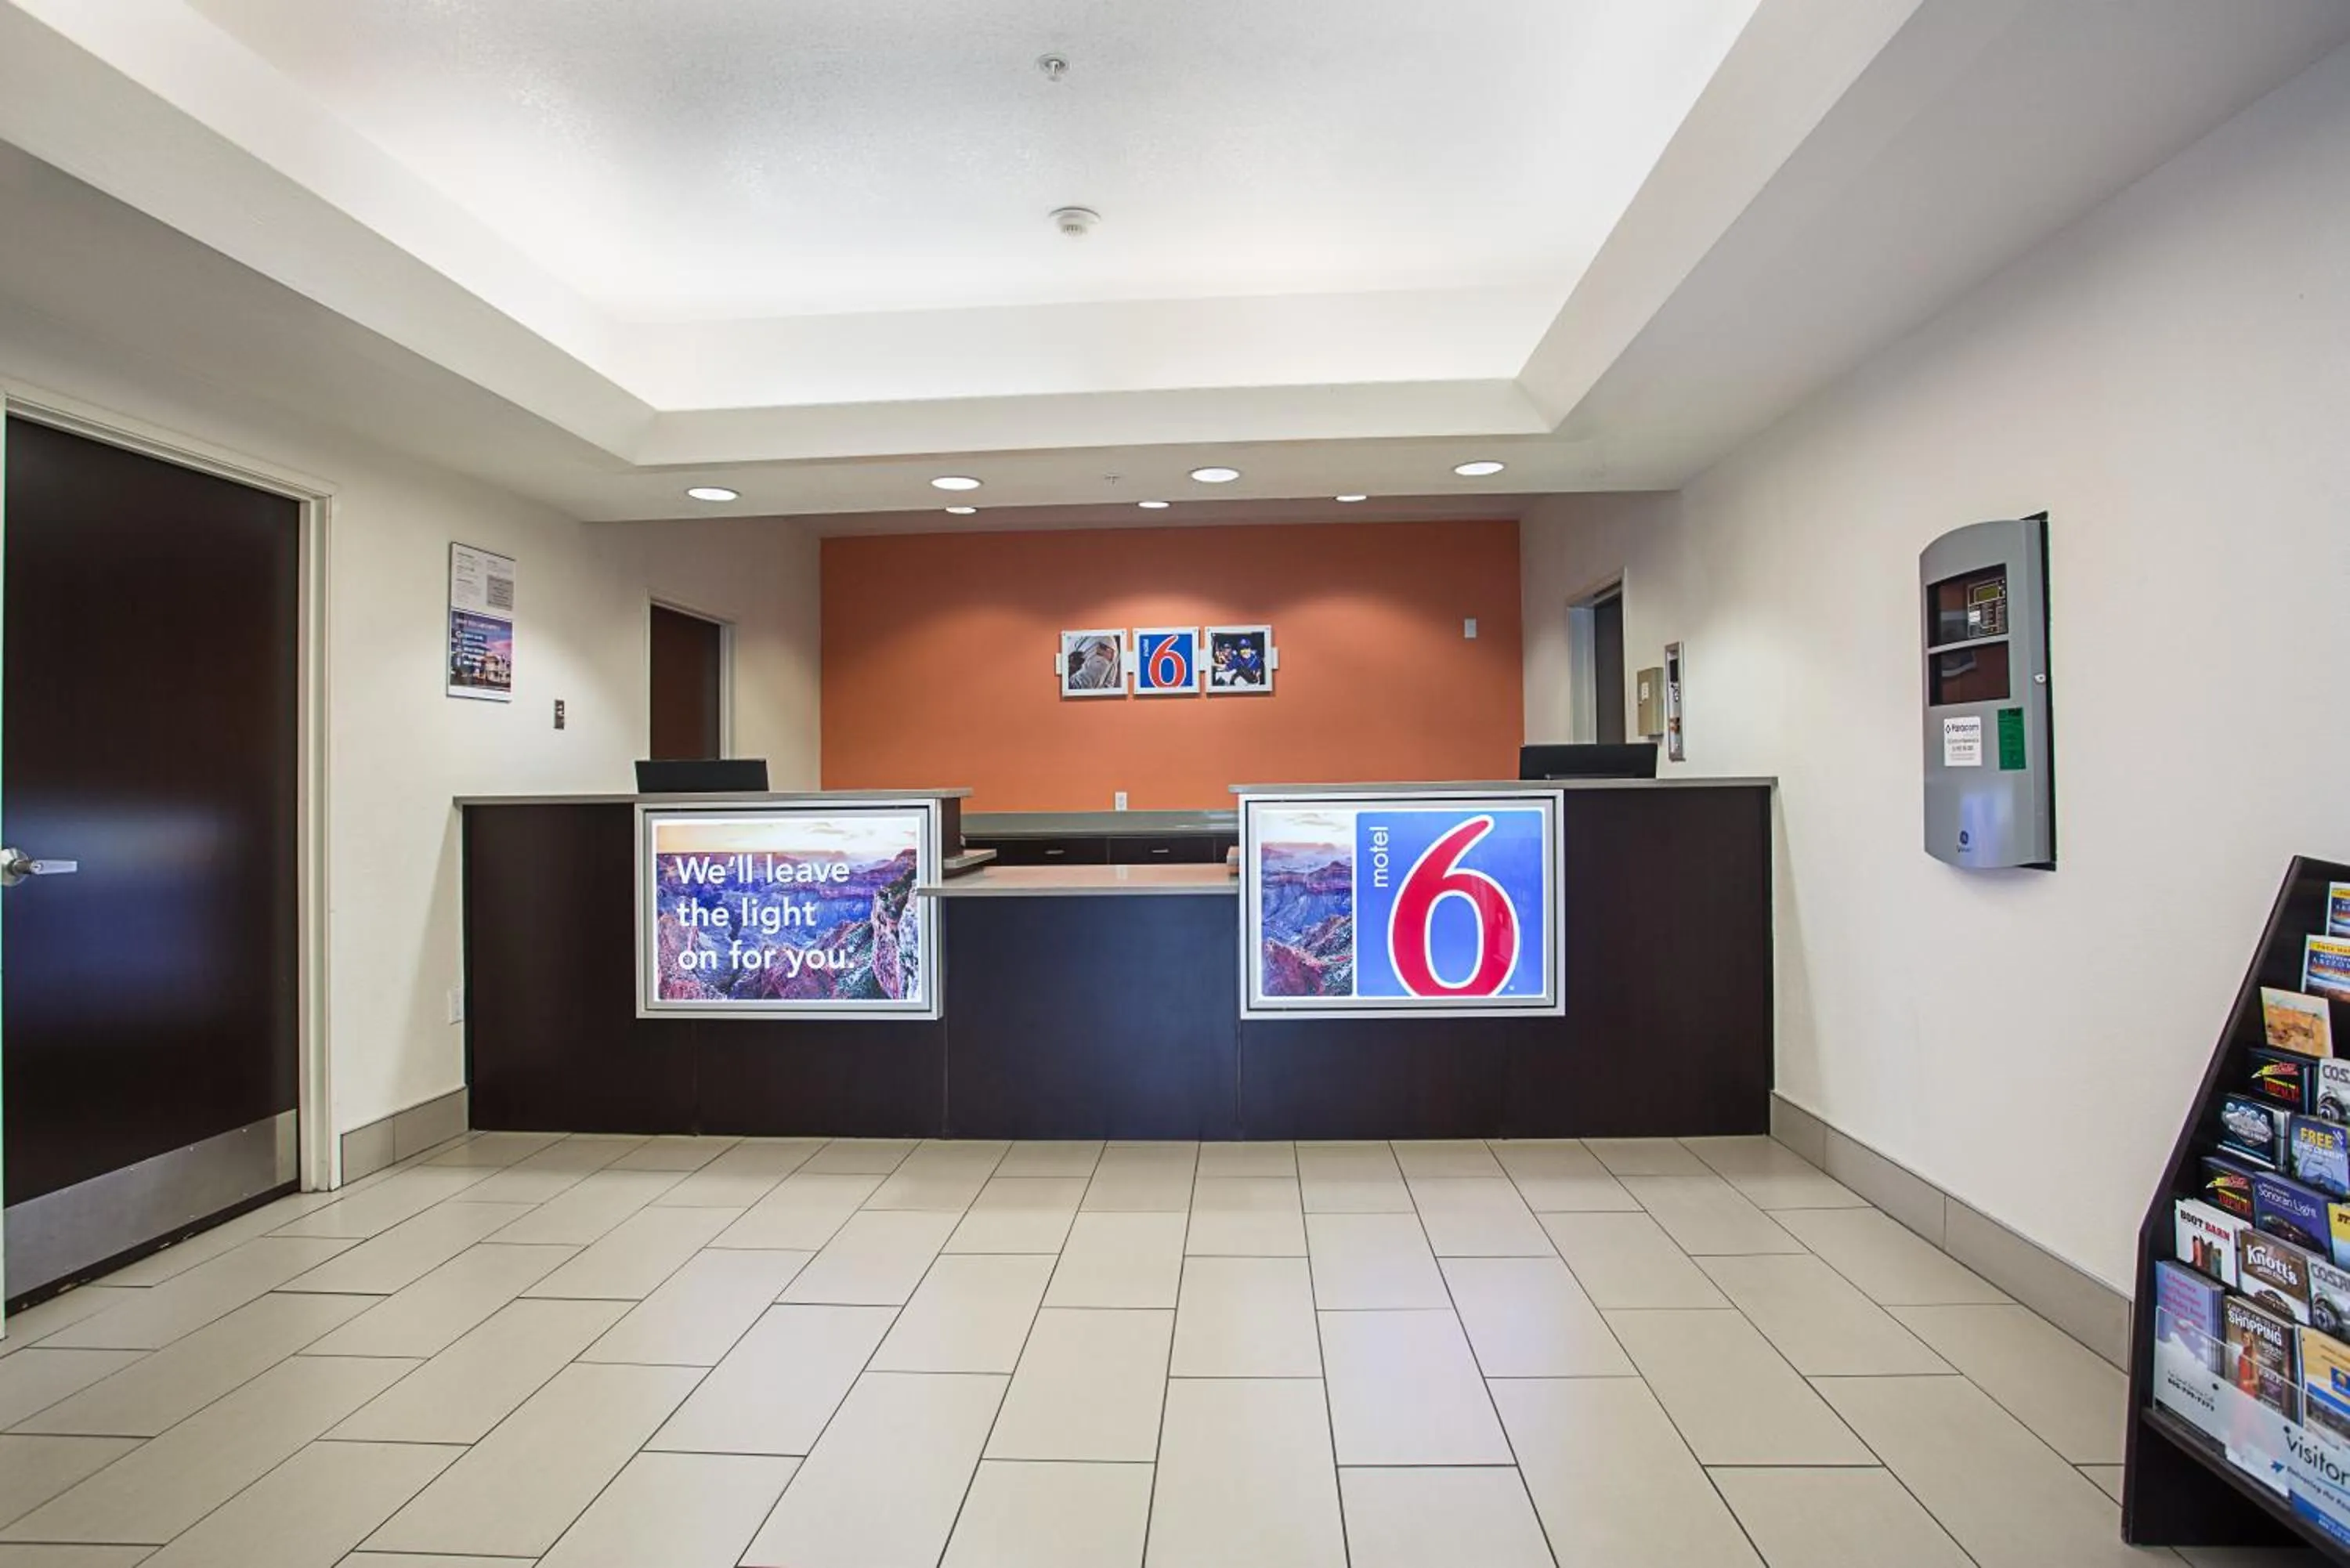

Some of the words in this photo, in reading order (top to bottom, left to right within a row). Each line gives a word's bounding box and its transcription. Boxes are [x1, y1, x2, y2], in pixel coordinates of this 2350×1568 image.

[1148, 634, 1187, 688] 6
[675, 854, 752, 884] We'll
[767, 854, 849, 883] leave
[1369, 826, 1389, 887] motel
[677, 898, 729, 927] the
[742, 897, 816, 934] light
[1387, 814, 1520, 996] 6
[678, 948, 716, 970] on
[729, 940, 777, 970] for
[786, 948, 855, 977] you.
[2322, 1064, 2350, 1083] COS
[2300, 1127, 2334, 1150] FREE
[2180, 1209, 2204, 1228] BOOT
[2205, 1220, 2230, 1241] BARN
[2247, 1244, 2298, 1285] Knott's
[2229, 1308, 2282, 1346] SHOPPING
